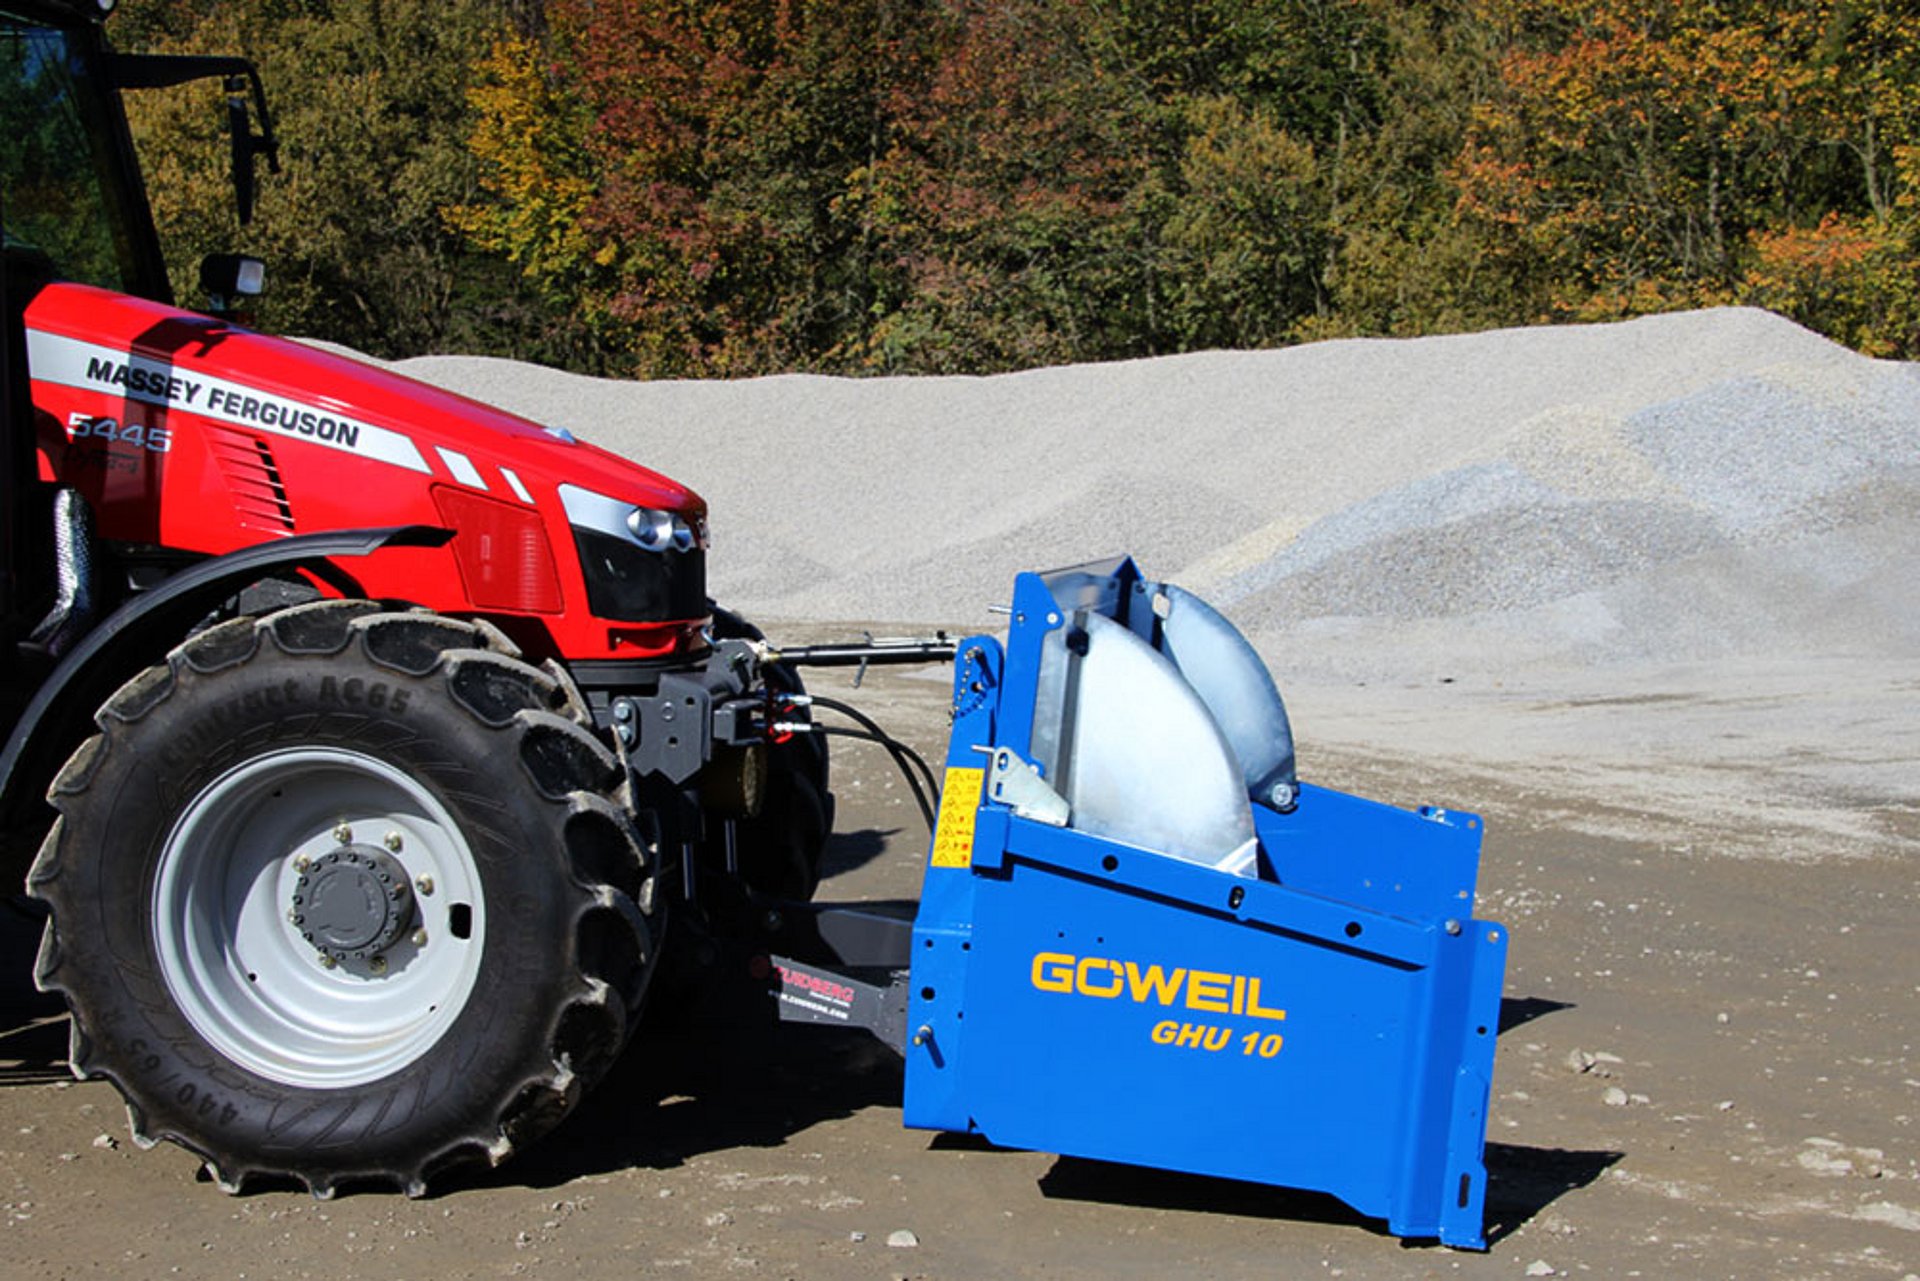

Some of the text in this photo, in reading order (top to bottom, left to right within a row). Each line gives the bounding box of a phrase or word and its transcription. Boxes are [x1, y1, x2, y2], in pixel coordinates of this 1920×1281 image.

[86, 357, 360, 447] MASSEY FERGUSON
[66, 411, 172, 452] 5445
[1151, 1020, 1284, 1058] GHU 10
